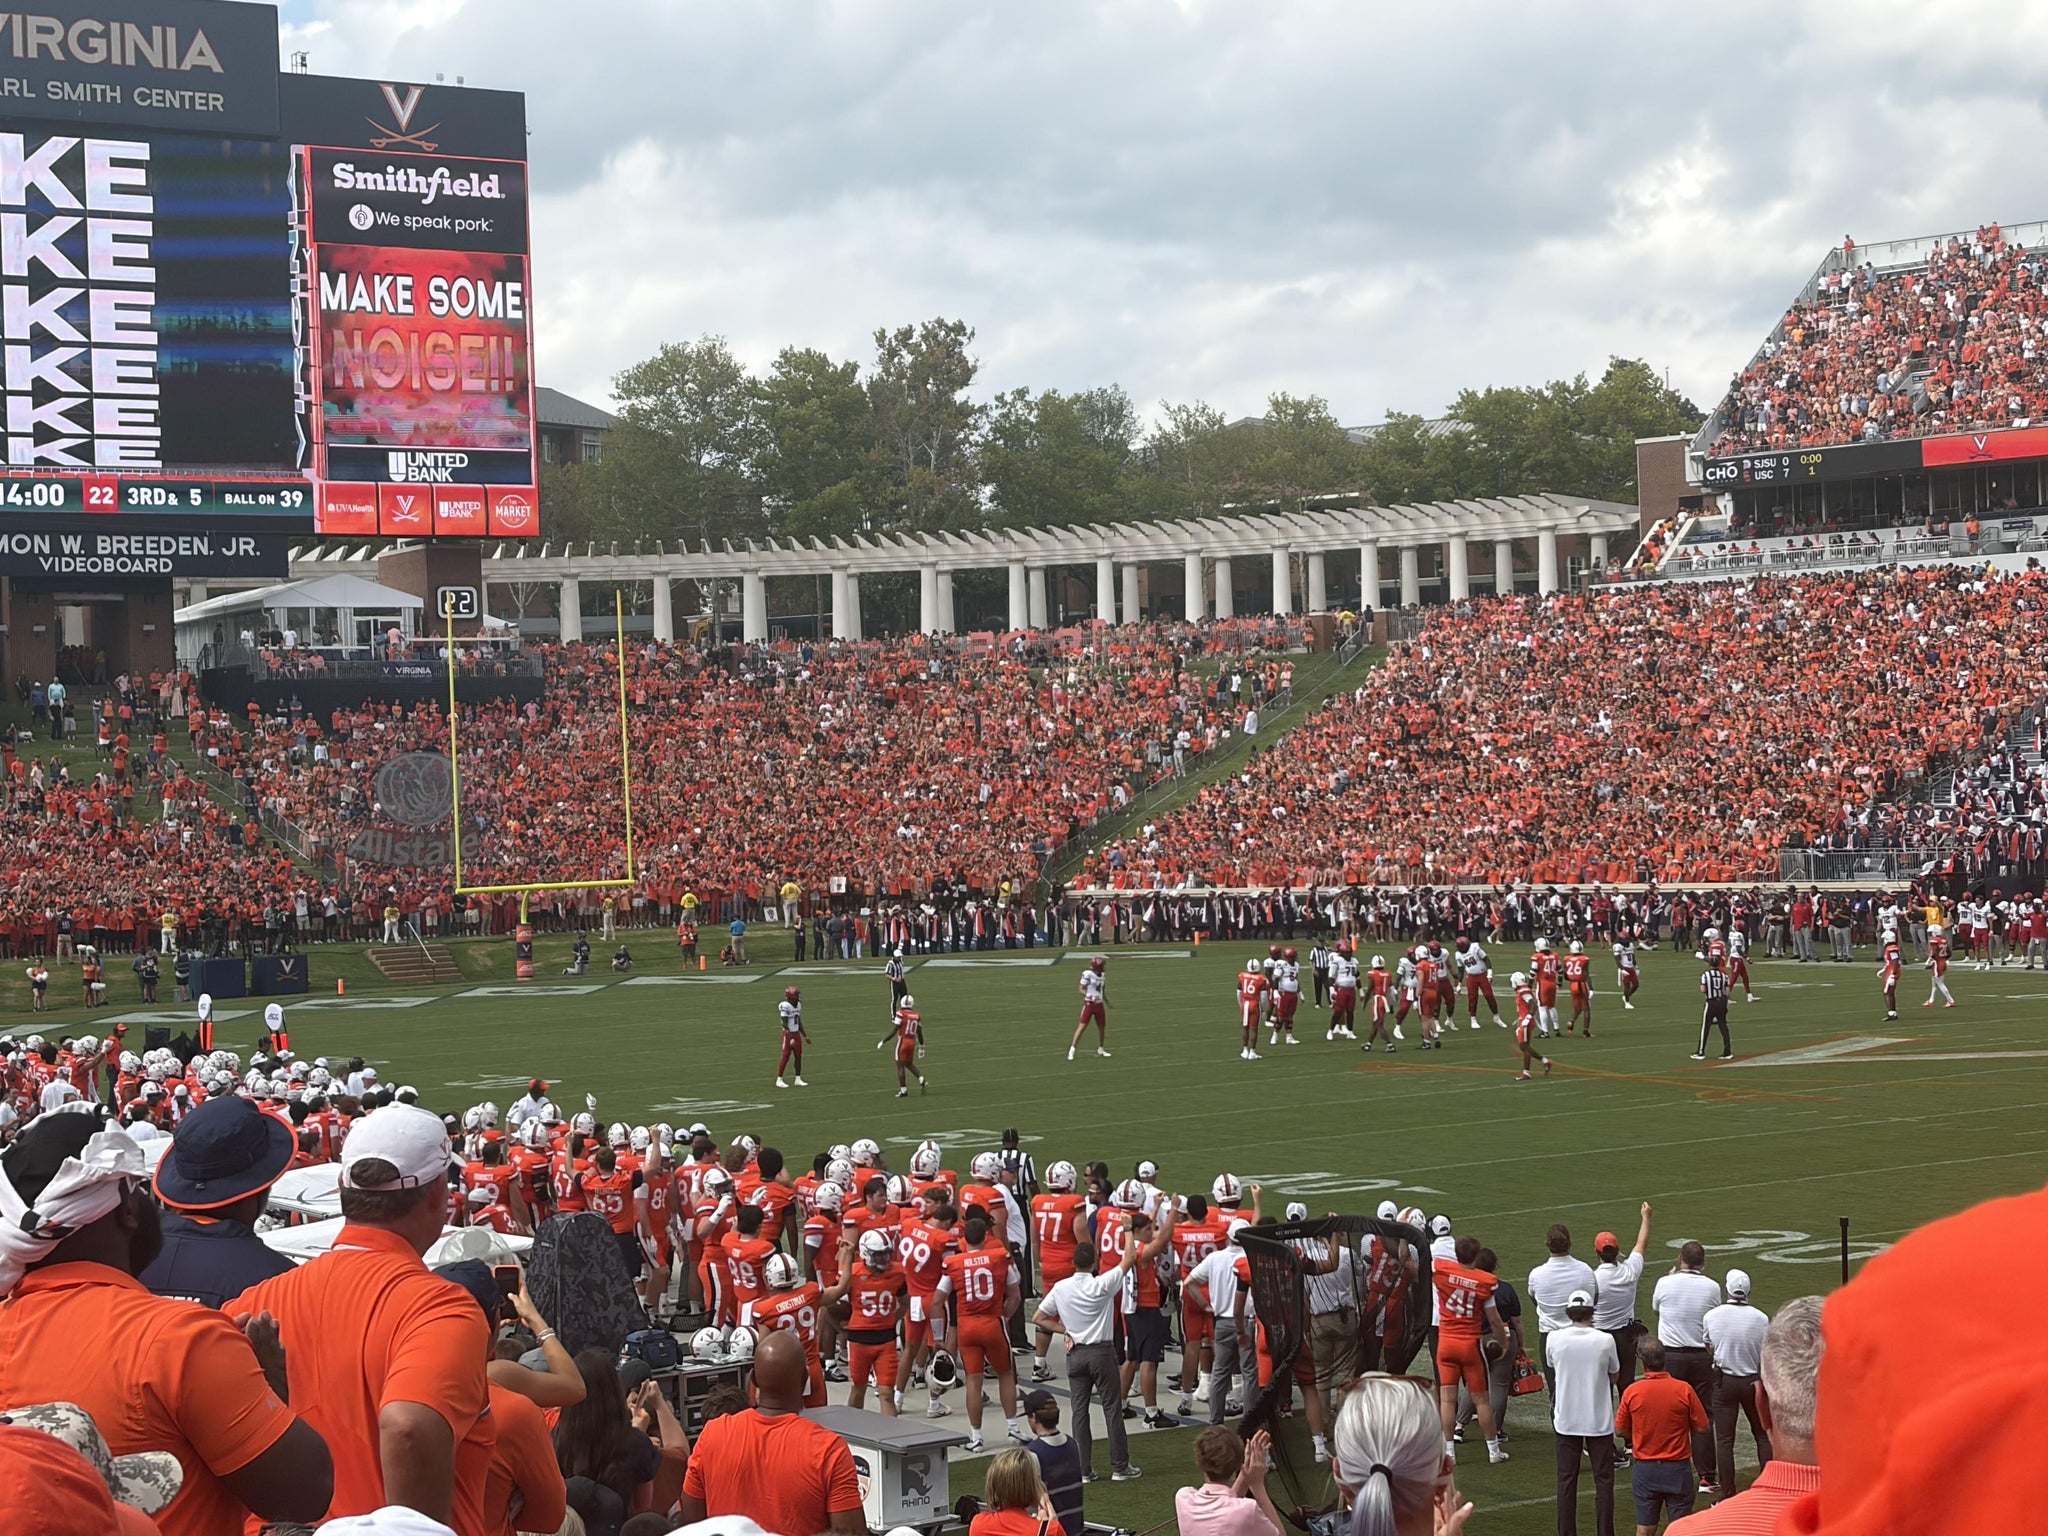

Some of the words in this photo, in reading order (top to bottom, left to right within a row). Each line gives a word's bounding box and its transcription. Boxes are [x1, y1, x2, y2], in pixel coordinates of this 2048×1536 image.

[0, 77, 36, 98] RL
[47, 80, 122, 104] SMITH
[133, 86, 224, 112] CENTER
[332, 162, 501, 204] Smithfield
[375, 211, 400, 227] We
[404, 213, 451, 231] speak
[319, 271, 414, 314] MAKE
[428, 275, 523, 319] SOME
[0, 284, 158, 345] KE
[332, 327, 514, 392] NOISE!!
[0, 345, 160, 395] KE
[0, 396, 162, 436] KE
[0, 437, 162, 468] KE
[407, 452, 468, 469] UNITED
[1800, 453, 1823, 465] 0:00
[1754, 458, 1777, 469] SJSU
[1782, 456, 1789, 466] 0
[1808, 465, 1816, 475] 1
[408, 467, 453, 482] BANK
[1706, 465, 1738, 480] CHO
[1755, 470, 1774, 480] USC
[1783, 468, 1790, 478] 7
[89, 487, 115, 505] 22
[189, 488, 203, 506] 5
[225, 494, 255, 505] BALL
[258, 495, 275, 505] ON
[280, 490, 304, 508] 39
[449, 501, 481, 511] UNITED
[449, 508, 474, 518] BANK
[495, 505, 531, 518] MARKET
[60, 534, 86, 555] W.
[222, 536, 261, 556] JR.
[39, 556, 173, 573] VIDEOBOARD
[395, 666, 432, 675] VIRGINIA
[345, 827, 480, 866] Allstate
[1566, 961, 1582, 975] 26
[1243, 978, 1256, 994] 16
[1712, 977, 1721, 989] U
[905, 1020, 918, 1035] 10
[593, 1195, 623, 1213] 65
[1036, 1212, 1062, 1242] 77
[899, 1237, 931, 1273] 99
[964, 1267, 994, 1302] 10
[861, 1290, 893, 1317] 50
[1445, 1288, 1476, 1319] 41
[902, 1496, 931, 1509] RHINO
